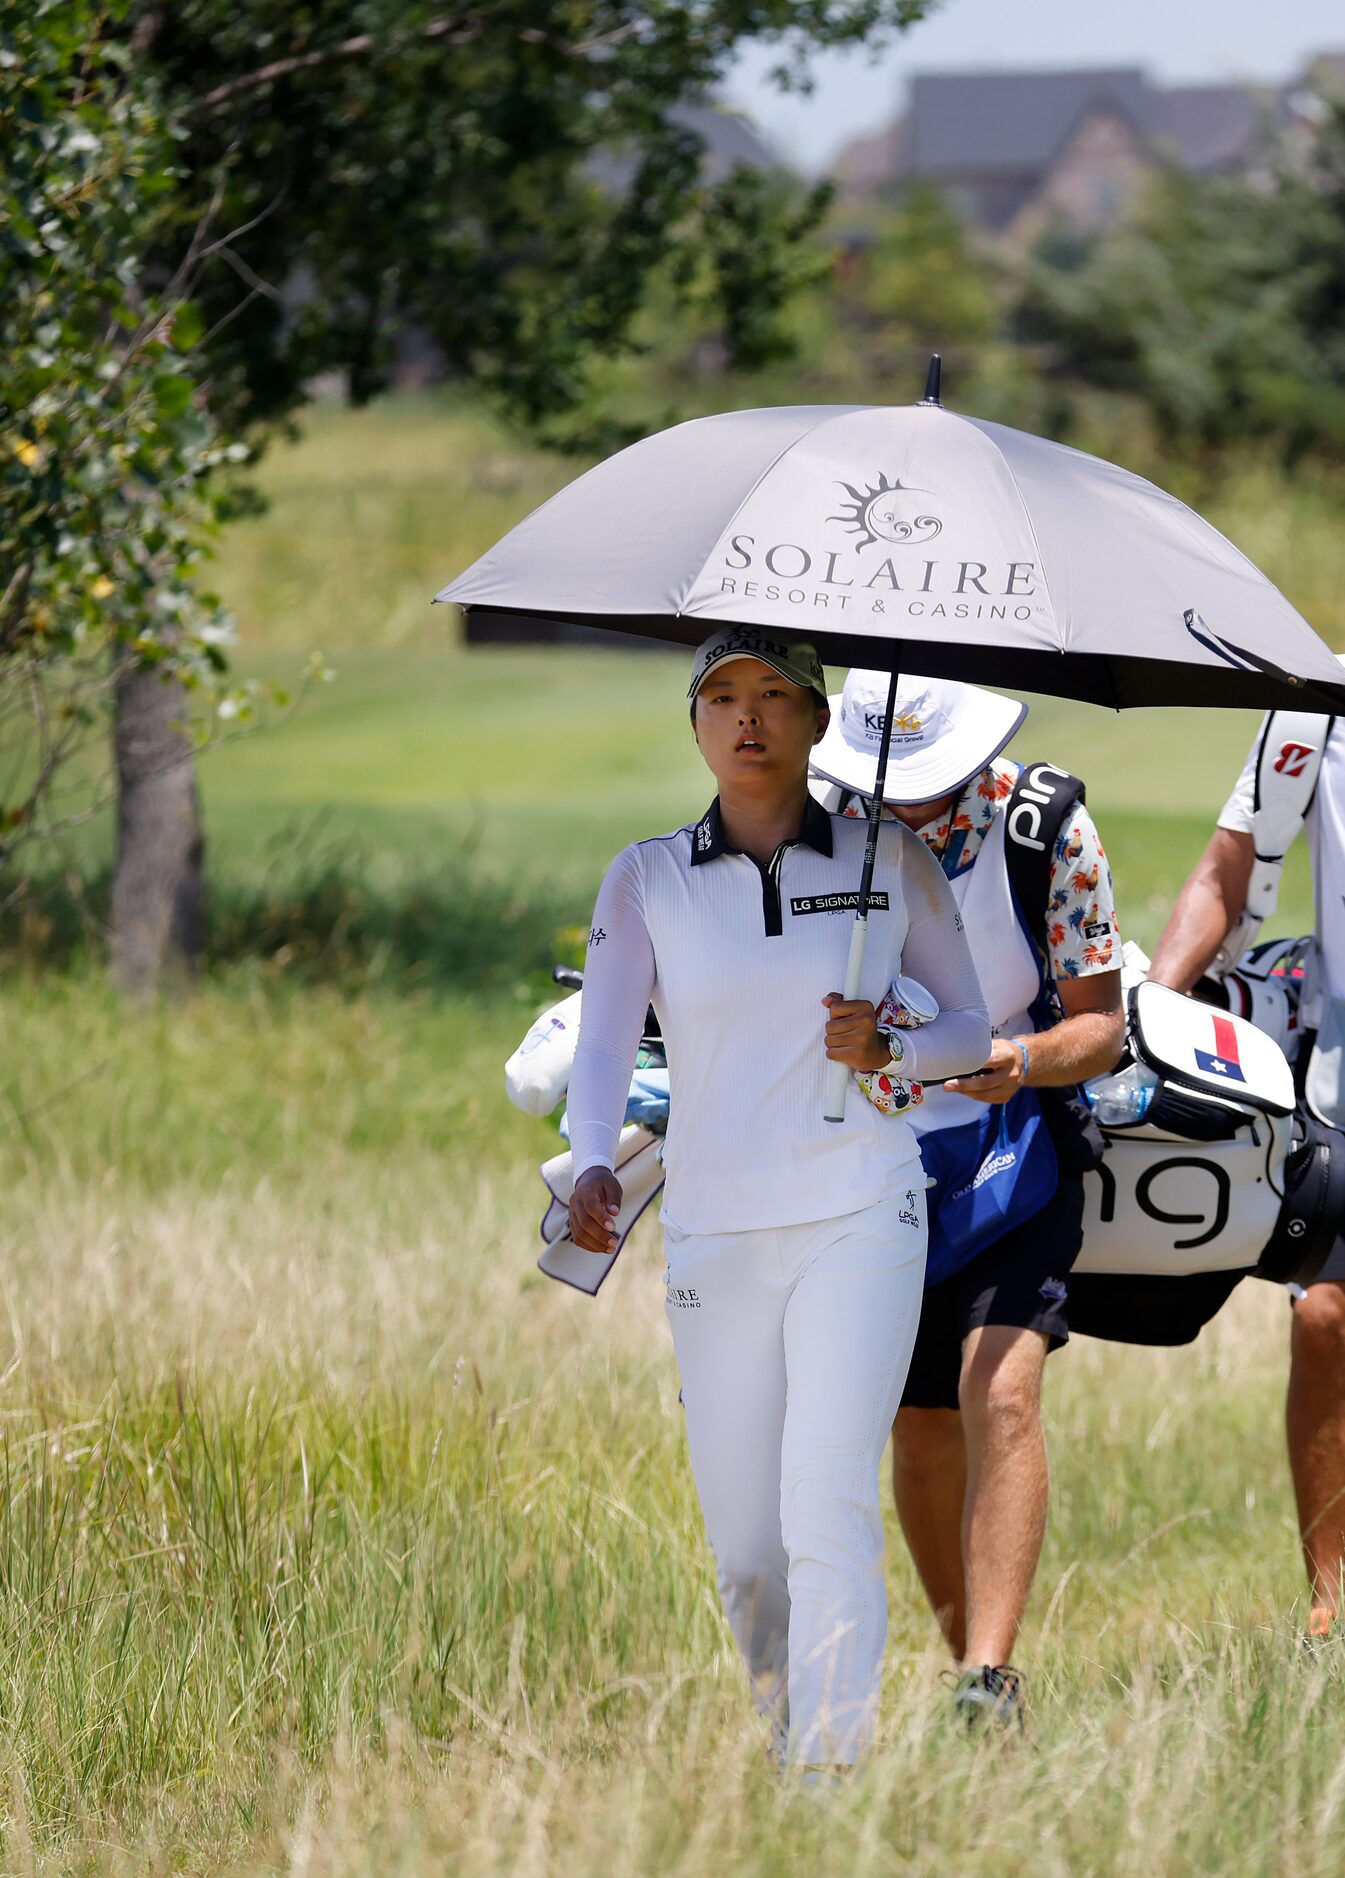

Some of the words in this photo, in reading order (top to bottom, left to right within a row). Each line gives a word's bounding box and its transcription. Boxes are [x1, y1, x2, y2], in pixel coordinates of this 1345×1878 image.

[724, 534, 1036, 596] SOLAIRE
[720, 576, 852, 610] RESORT
[870, 598, 887, 614] &
[907, 601, 1032, 621] CASINO
[704, 639, 789, 666] SOLAIRE
[904, 735, 924, 743] Group
[1008, 762, 1071, 851] pin
[793, 900, 812, 912] LG
[815, 895, 888, 909] SIGNATRE
[898, 1209, 920, 1224] LPGA
